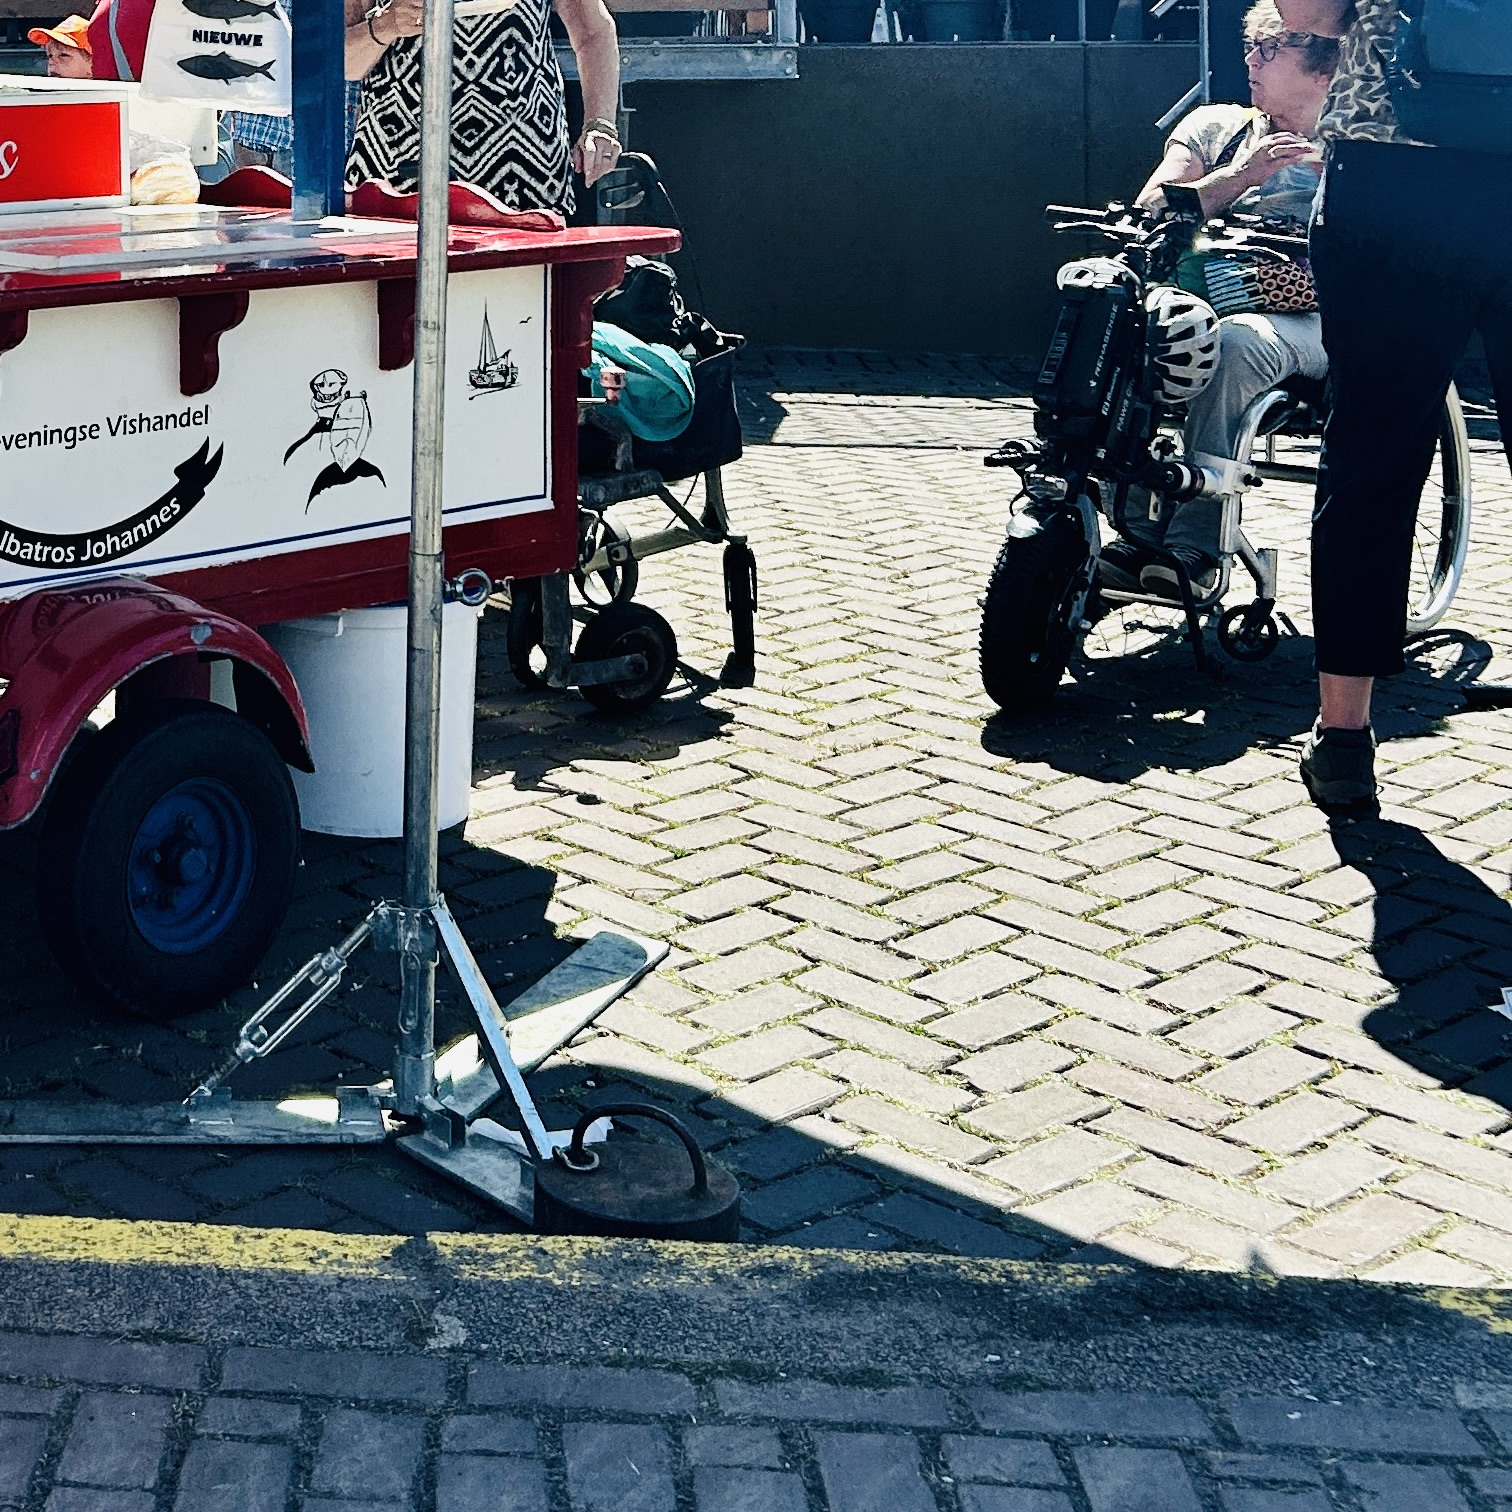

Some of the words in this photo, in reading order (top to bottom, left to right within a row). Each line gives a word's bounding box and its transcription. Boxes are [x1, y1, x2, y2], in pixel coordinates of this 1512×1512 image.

[192, 29, 264, 47] NIEUWE
[106, 404, 210, 437] Vishandel
[81, 497, 181, 562] Johannes
